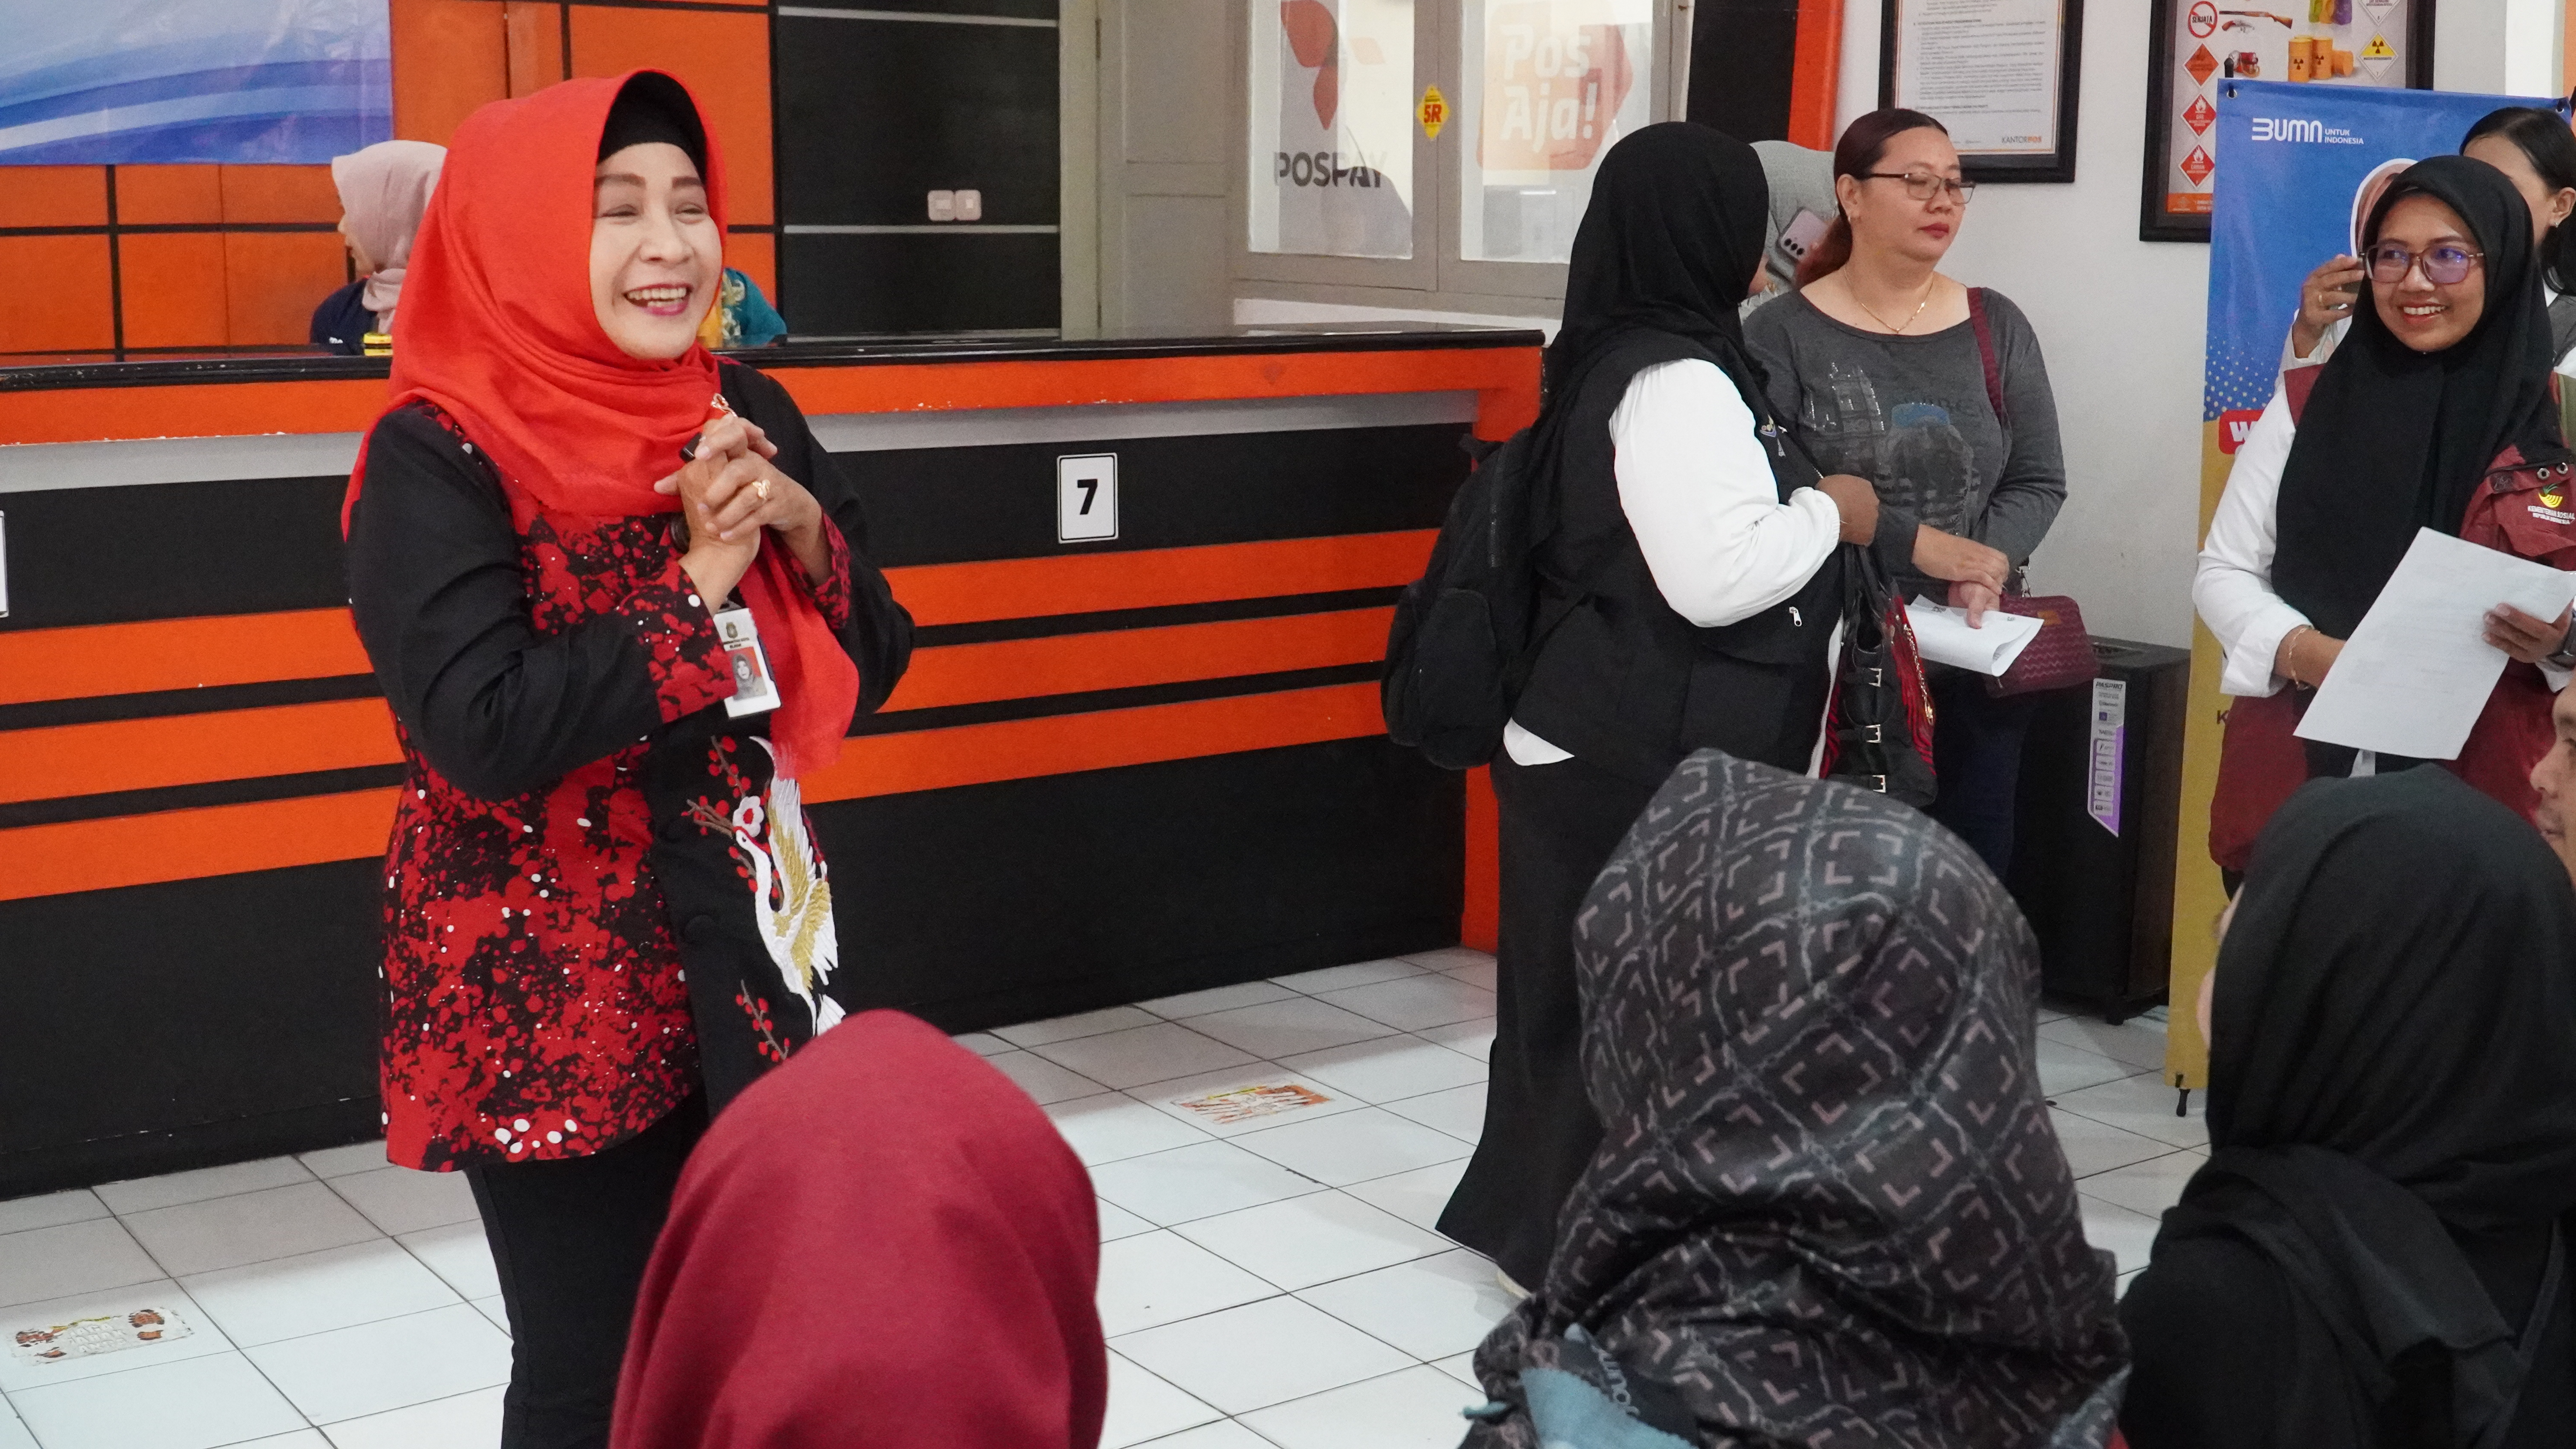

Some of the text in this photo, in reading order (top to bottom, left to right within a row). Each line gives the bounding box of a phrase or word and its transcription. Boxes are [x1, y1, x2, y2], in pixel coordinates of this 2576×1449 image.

[1503, 24, 1592, 80] Pos
[1424, 104, 1442, 123] 5R
[1501, 82, 1598, 153] Aja!
[1274, 151, 1387, 188] POSPAY
[2229, 421, 2257, 442] W
[1077, 479, 1098, 515] 7
[2217, 710, 2230, 724] K
